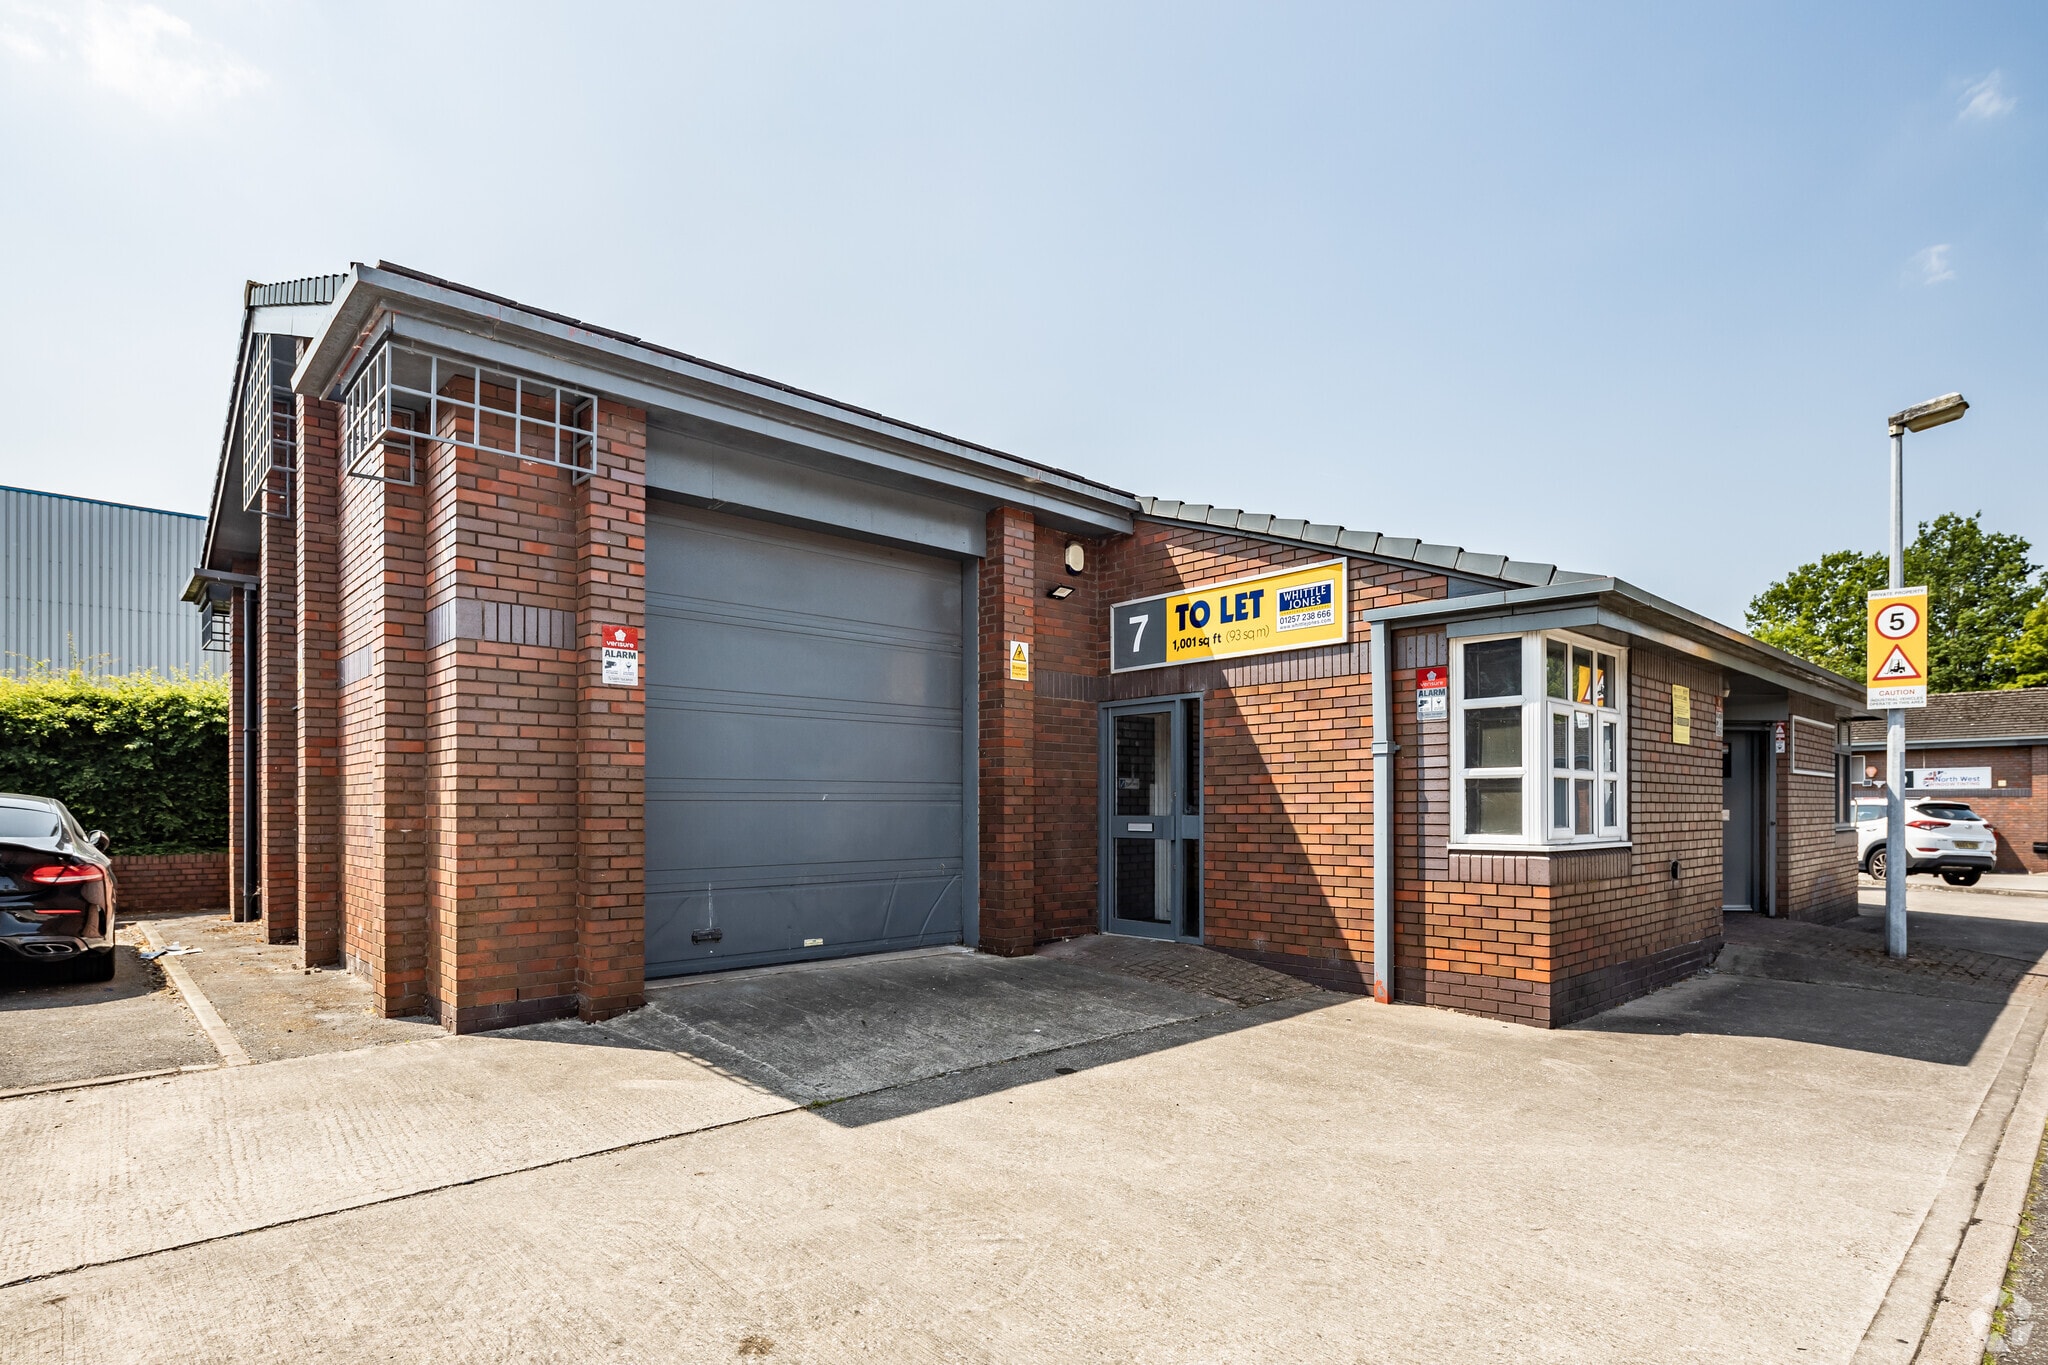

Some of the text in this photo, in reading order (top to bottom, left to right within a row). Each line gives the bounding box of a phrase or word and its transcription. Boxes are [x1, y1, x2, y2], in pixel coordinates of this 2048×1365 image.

[1283, 585, 1326, 601] WHITTLE
[1175, 589, 1264, 631] TO LET
[1289, 596, 1321, 610] JONES
[1280, 610, 1331, 625] 01257 238 666
[1889, 612, 1905, 631] 5
[1129, 614, 1149, 653] 7
[1173, 625, 1270, 652] 1,001 sq ft (93 sq m)
[604, 650, 636, 660] ALARM
[1418, 689, 1445, 698] ALARM
